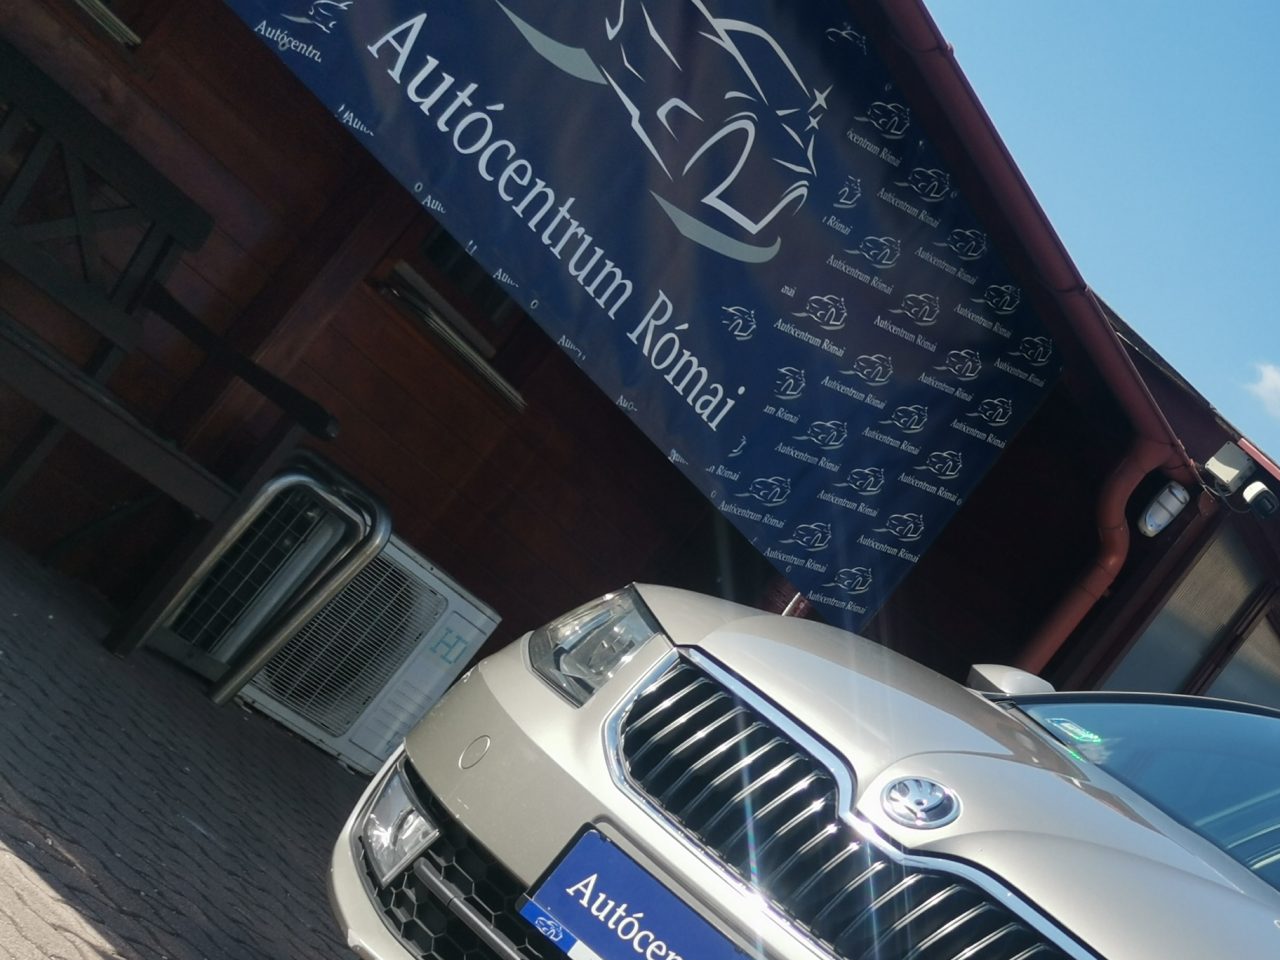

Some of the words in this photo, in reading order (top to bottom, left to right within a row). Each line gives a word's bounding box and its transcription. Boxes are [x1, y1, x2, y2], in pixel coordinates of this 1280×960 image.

[367, 12, 634, 320] Autócentrum
[626, 289, 746, 431] Római
[826, 254, 870, 284] Autócentrum
[773, 318, 822, 347] Autócentrum
[873, 315, 917, 344] Autócentrum
[821, 376, 864, 401] Autócentrum
[862, 426, 900, 448] Autócentrum
[950, 419, 987, 441] Autócentrum
[775, 442, 818, 465] Autócentrum
[898, 472, 937, 494] Autócentrum
[817, 489, 857, 510] Autócentrum
[718, 500, 762, 522] Autócentrum
[857, 534, 898, 555] Autócentrum
[764, 547, 805, 567] Autócentrum
[806, 590, 846, 609] Autócentrum
